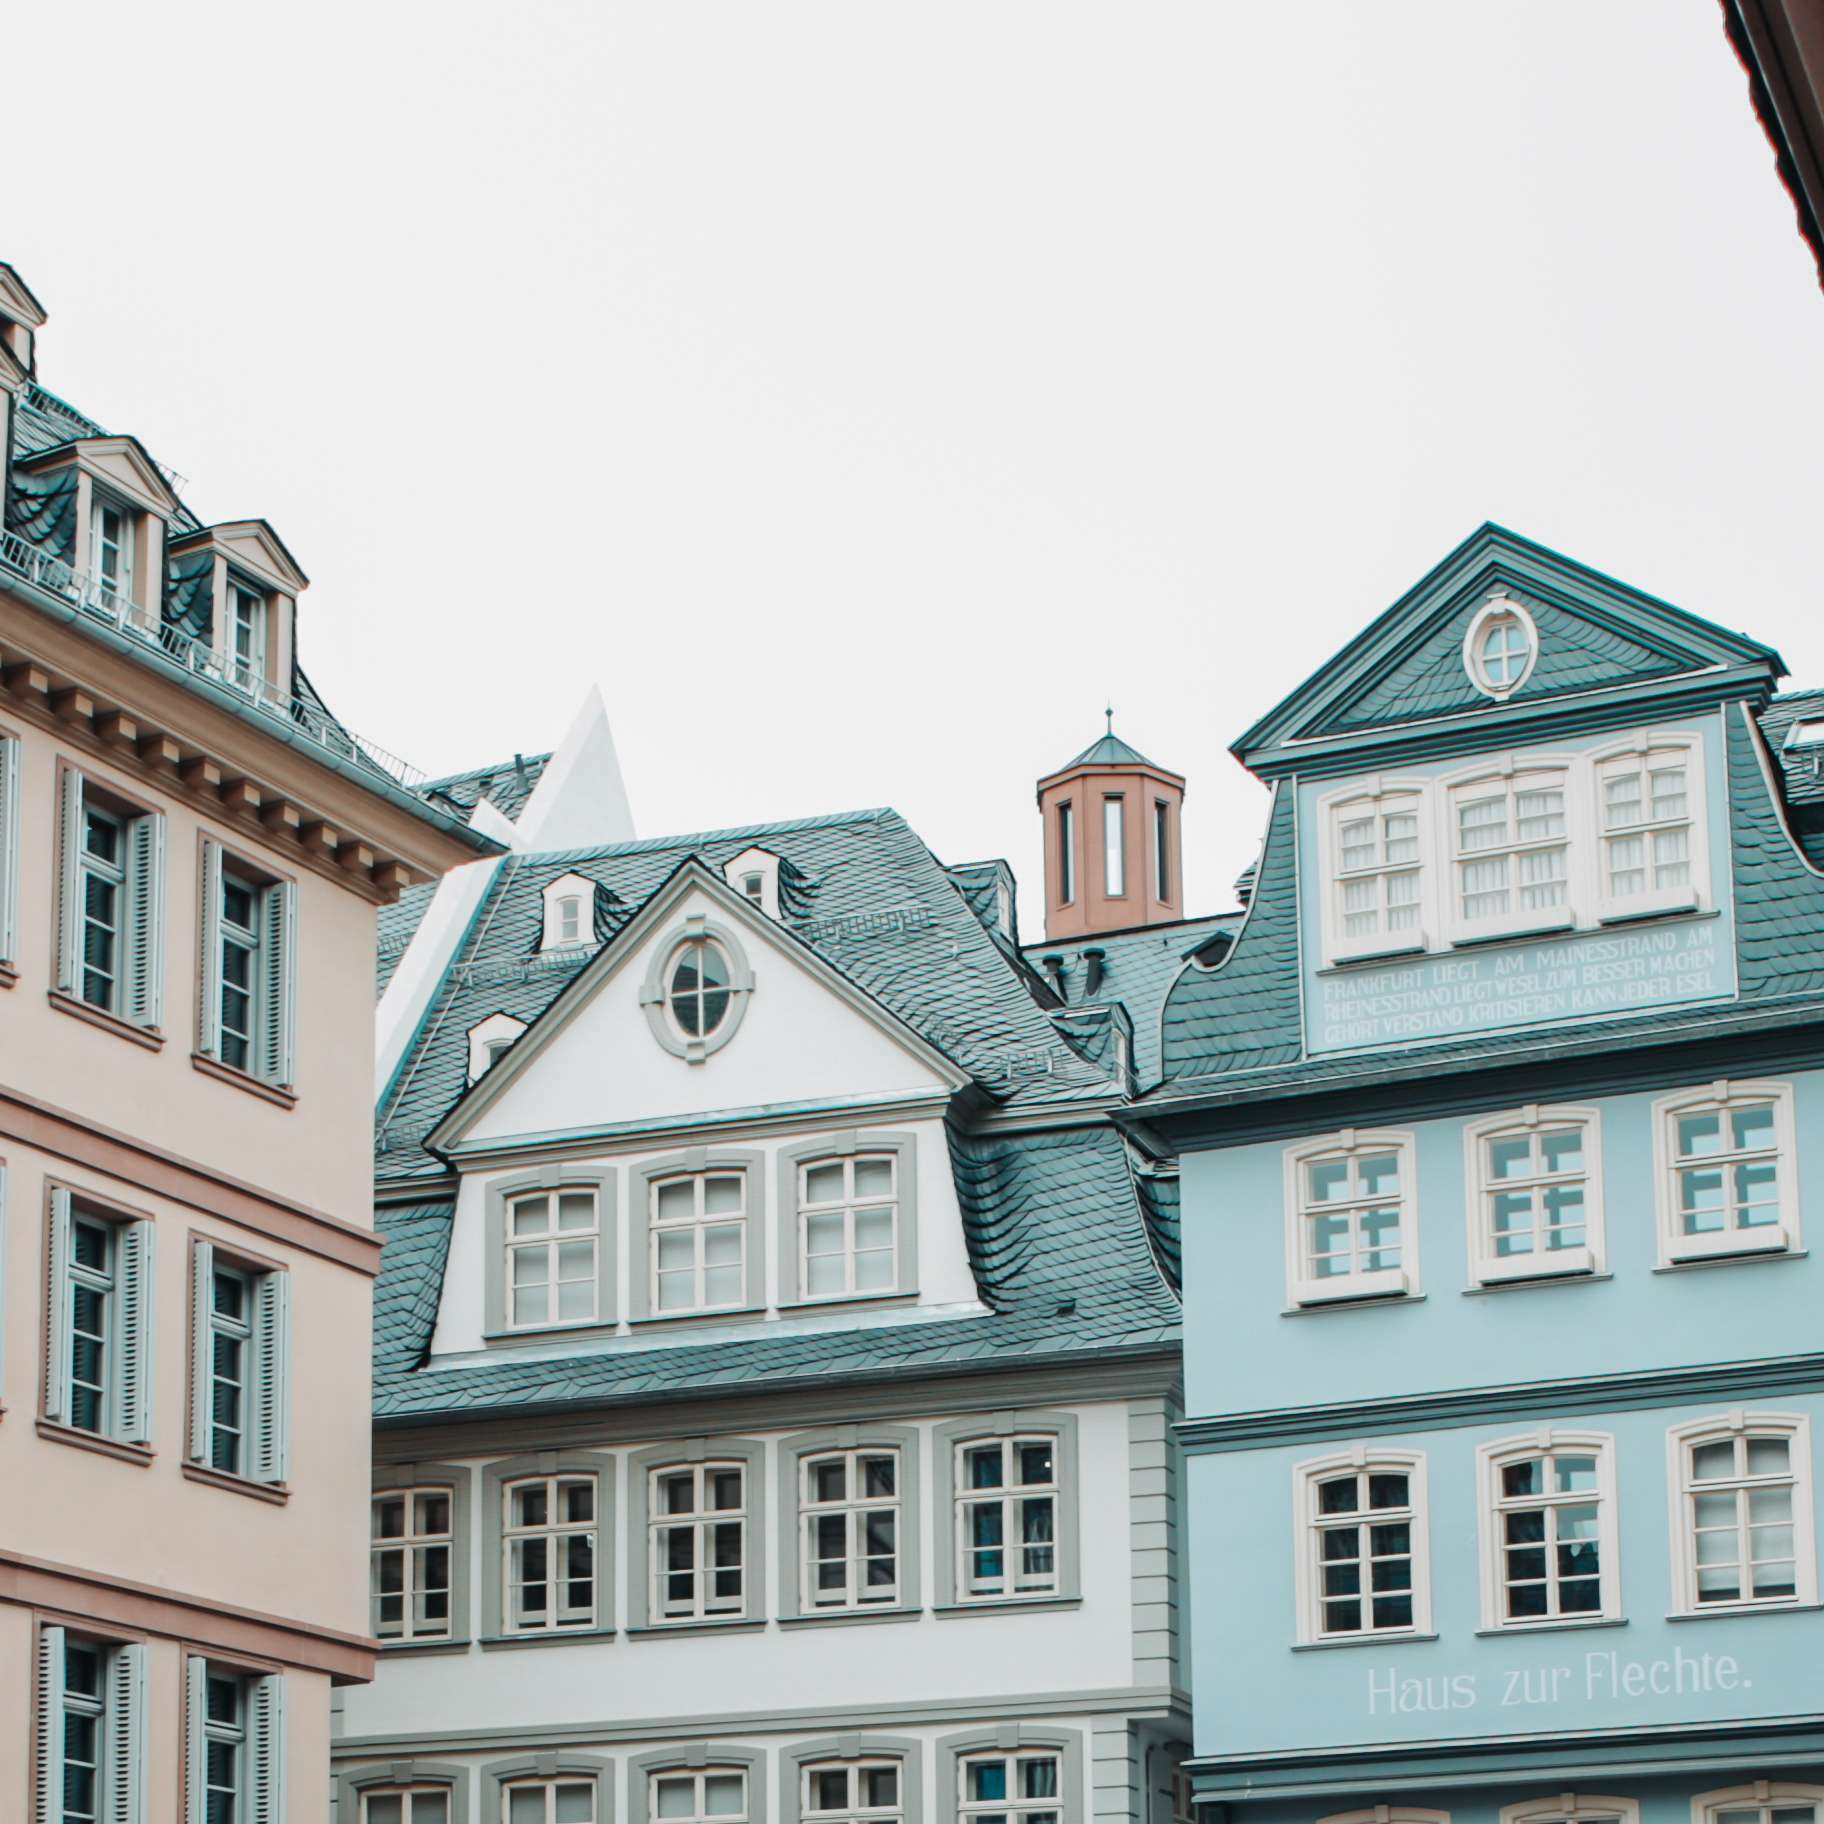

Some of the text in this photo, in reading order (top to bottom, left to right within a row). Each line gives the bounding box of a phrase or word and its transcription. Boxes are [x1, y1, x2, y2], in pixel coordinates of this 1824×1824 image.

[1324, 926, 1713, 1001] FRANKFURT LIEGT AM MAINESSTRAND AM
[1324, 987, 1451, 1021] RHEINESSTRAND
[1454, 981, 1494, 1004] LIEGT
[1582, 957, 1646, 985] BESSER
[1649, 948, 1714, 976] MACHEN
[1384, 1007, 1464, 1034] VERSTAND
[1469, 993, 1565, 1023] KRITISIEREN
[1572, 986, 1617, 1008] KANN
[1619, 977, 1671, 1001] JEDER
[1677, 971, 1714, 994] ESEL
[1367, 1646, 1752, 1714] Haus zur Flechte.
